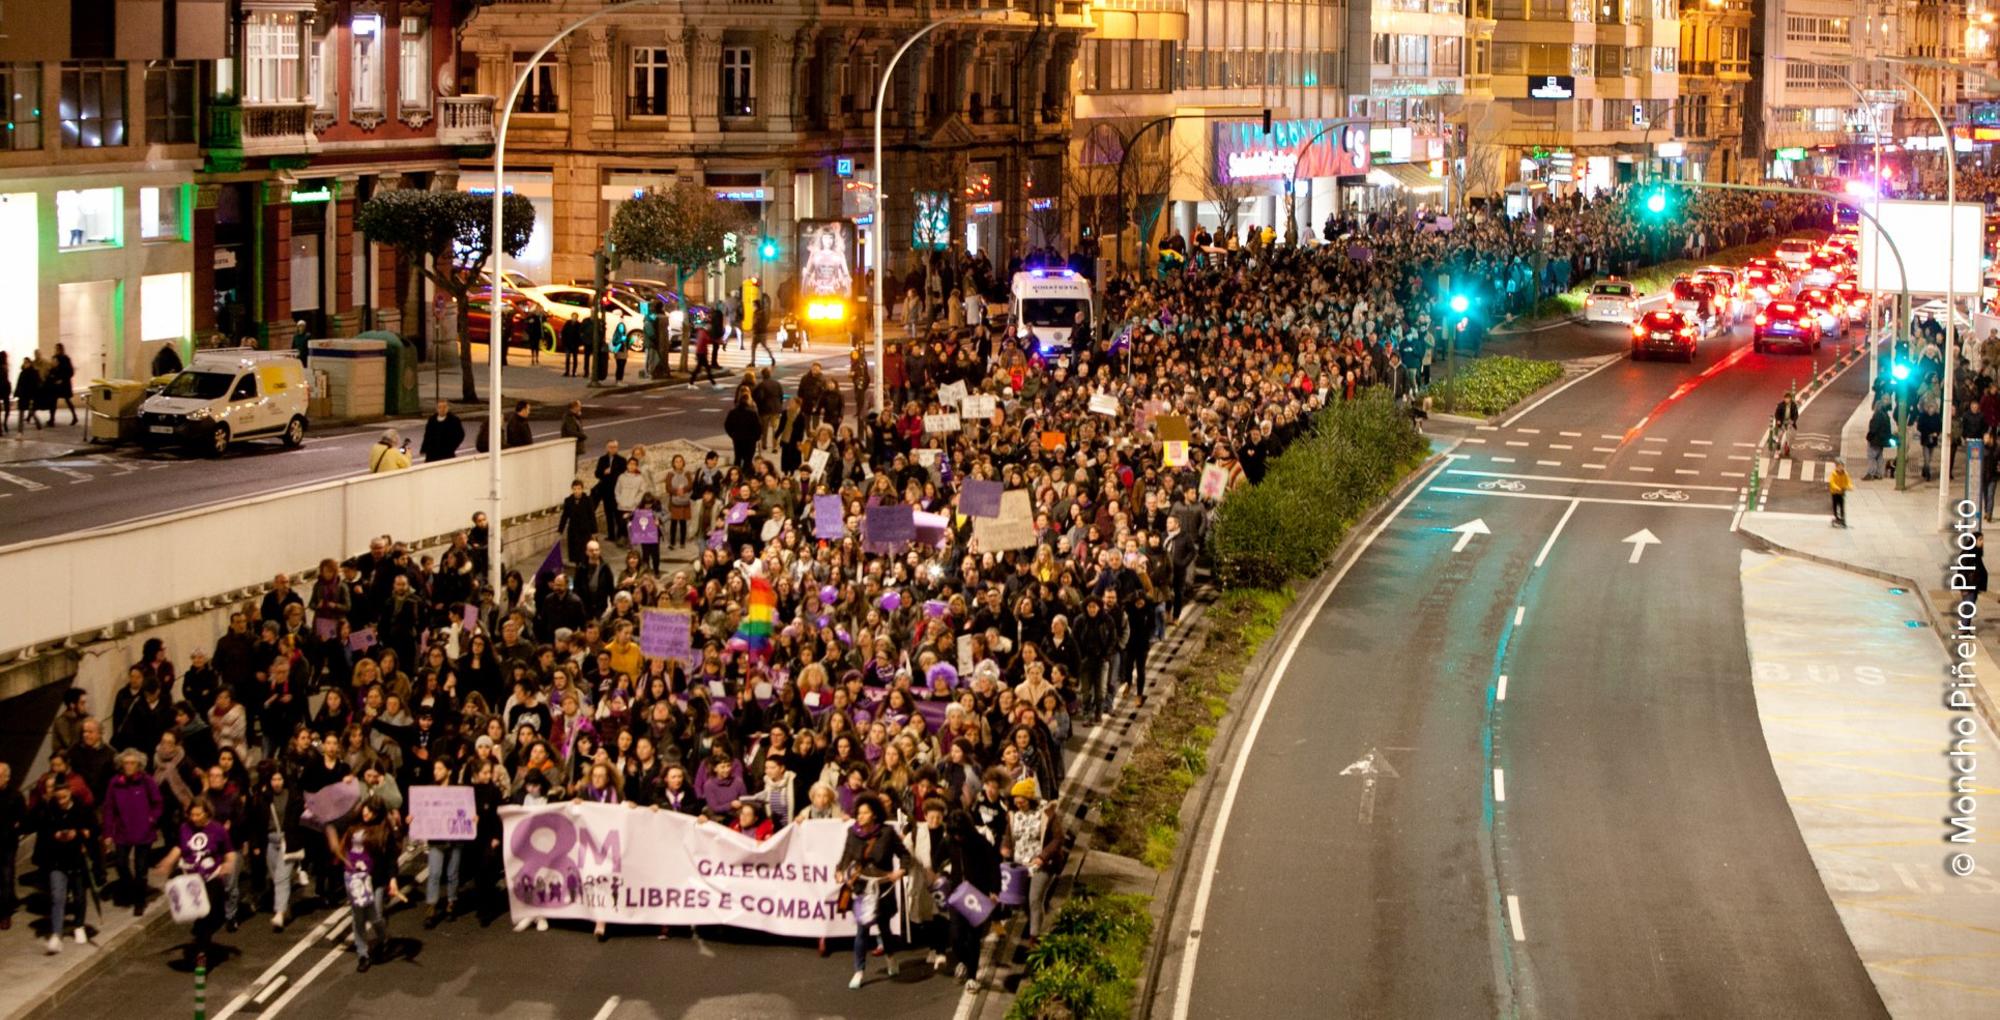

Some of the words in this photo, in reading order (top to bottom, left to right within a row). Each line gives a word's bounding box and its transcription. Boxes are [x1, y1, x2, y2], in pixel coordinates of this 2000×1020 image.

[1755, 662, 1887, 686] BUS
[510, 811, 622, 908] 8M
[698, 859, 797, 881] GALEGAS
[802, 865, 828, 883] EN
[626, 887, 710, 908] LIBRES
[718, 892, 732, 910] E
